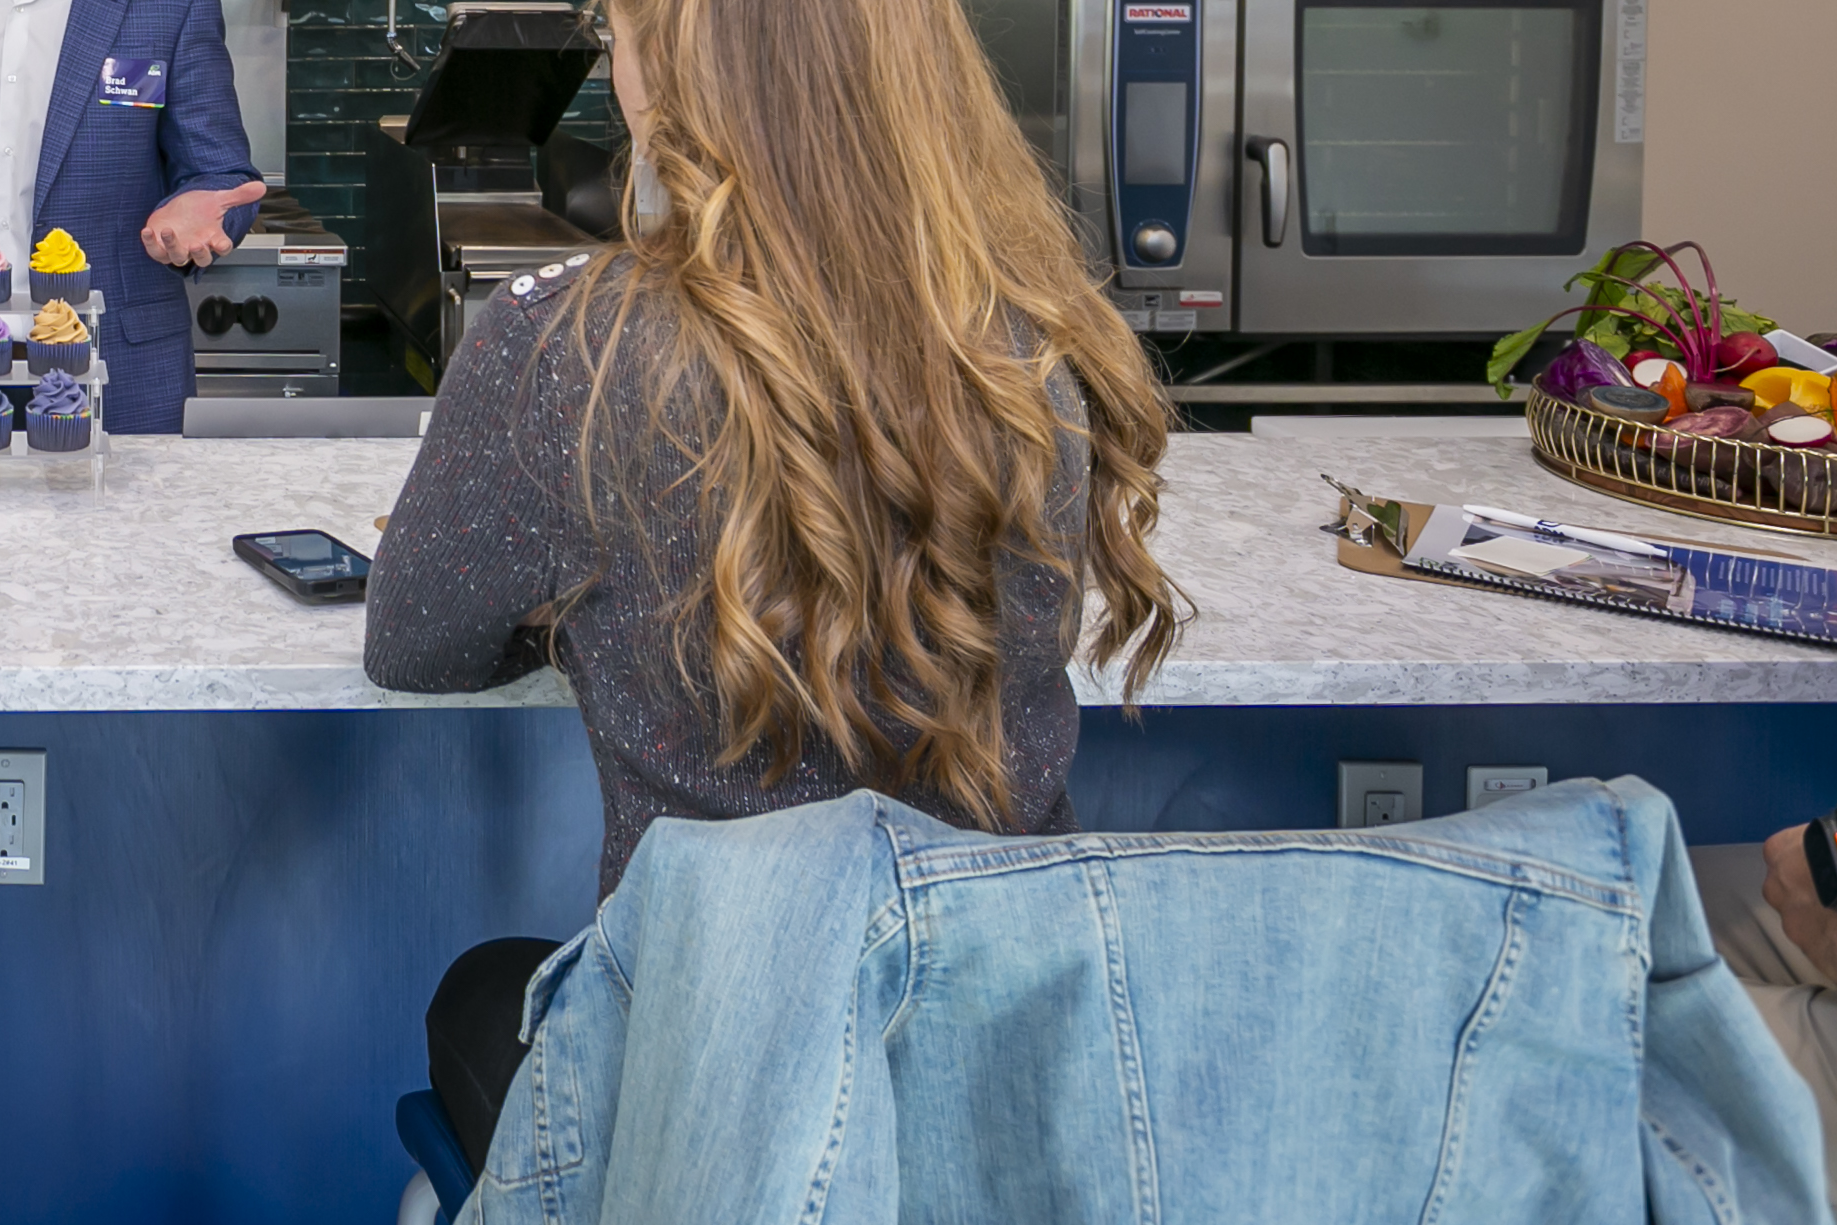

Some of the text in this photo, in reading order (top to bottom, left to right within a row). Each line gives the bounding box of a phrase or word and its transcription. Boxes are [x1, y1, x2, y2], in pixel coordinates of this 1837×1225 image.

[1129, 9, 1187, 18] RATIONAL
[105, 76, 126, 86] Brad
[104, 85, 138, 96] Schwan
